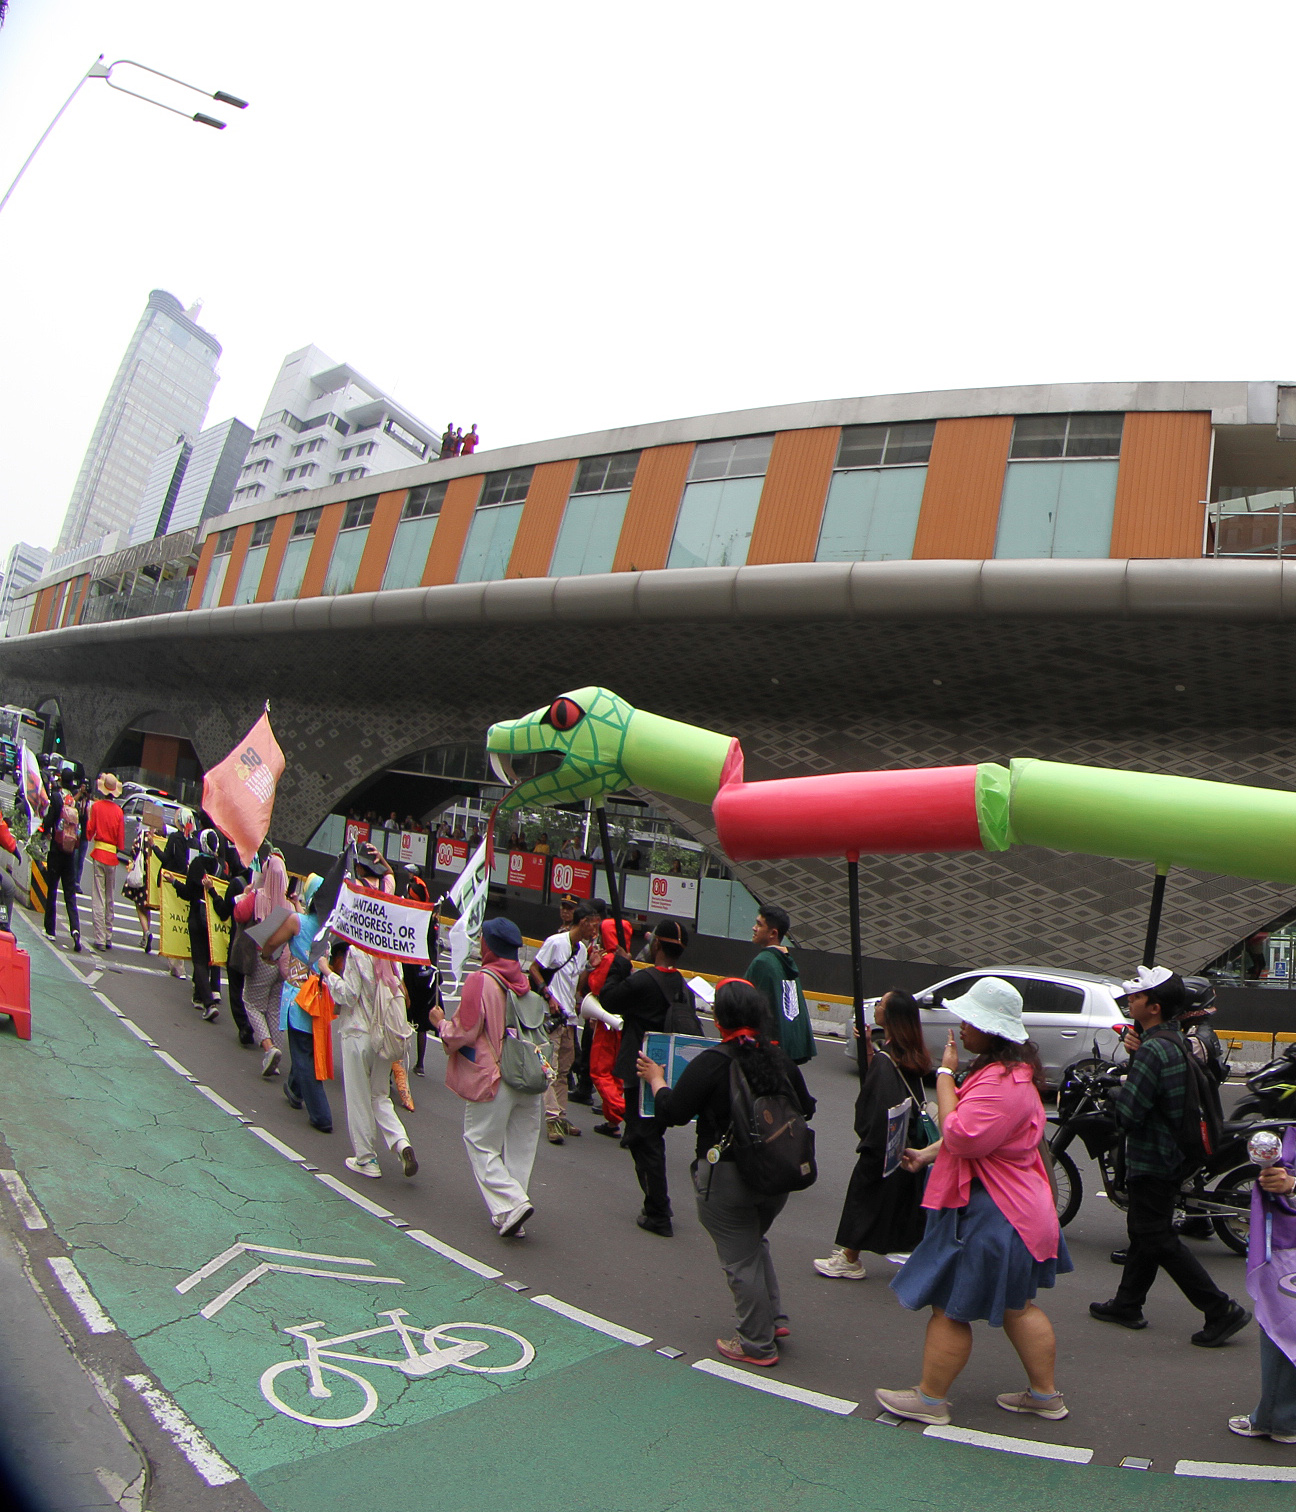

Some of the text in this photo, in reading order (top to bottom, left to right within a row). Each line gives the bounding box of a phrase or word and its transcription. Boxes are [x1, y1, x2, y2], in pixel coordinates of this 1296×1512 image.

[554, 863, 573, 891] 80
[652, 878, 668, 896] 80
[350, 925, 363, 940] THE
[364, 930, 416, 954] PROBLEM?
[398, 925, 416, 940] OR
